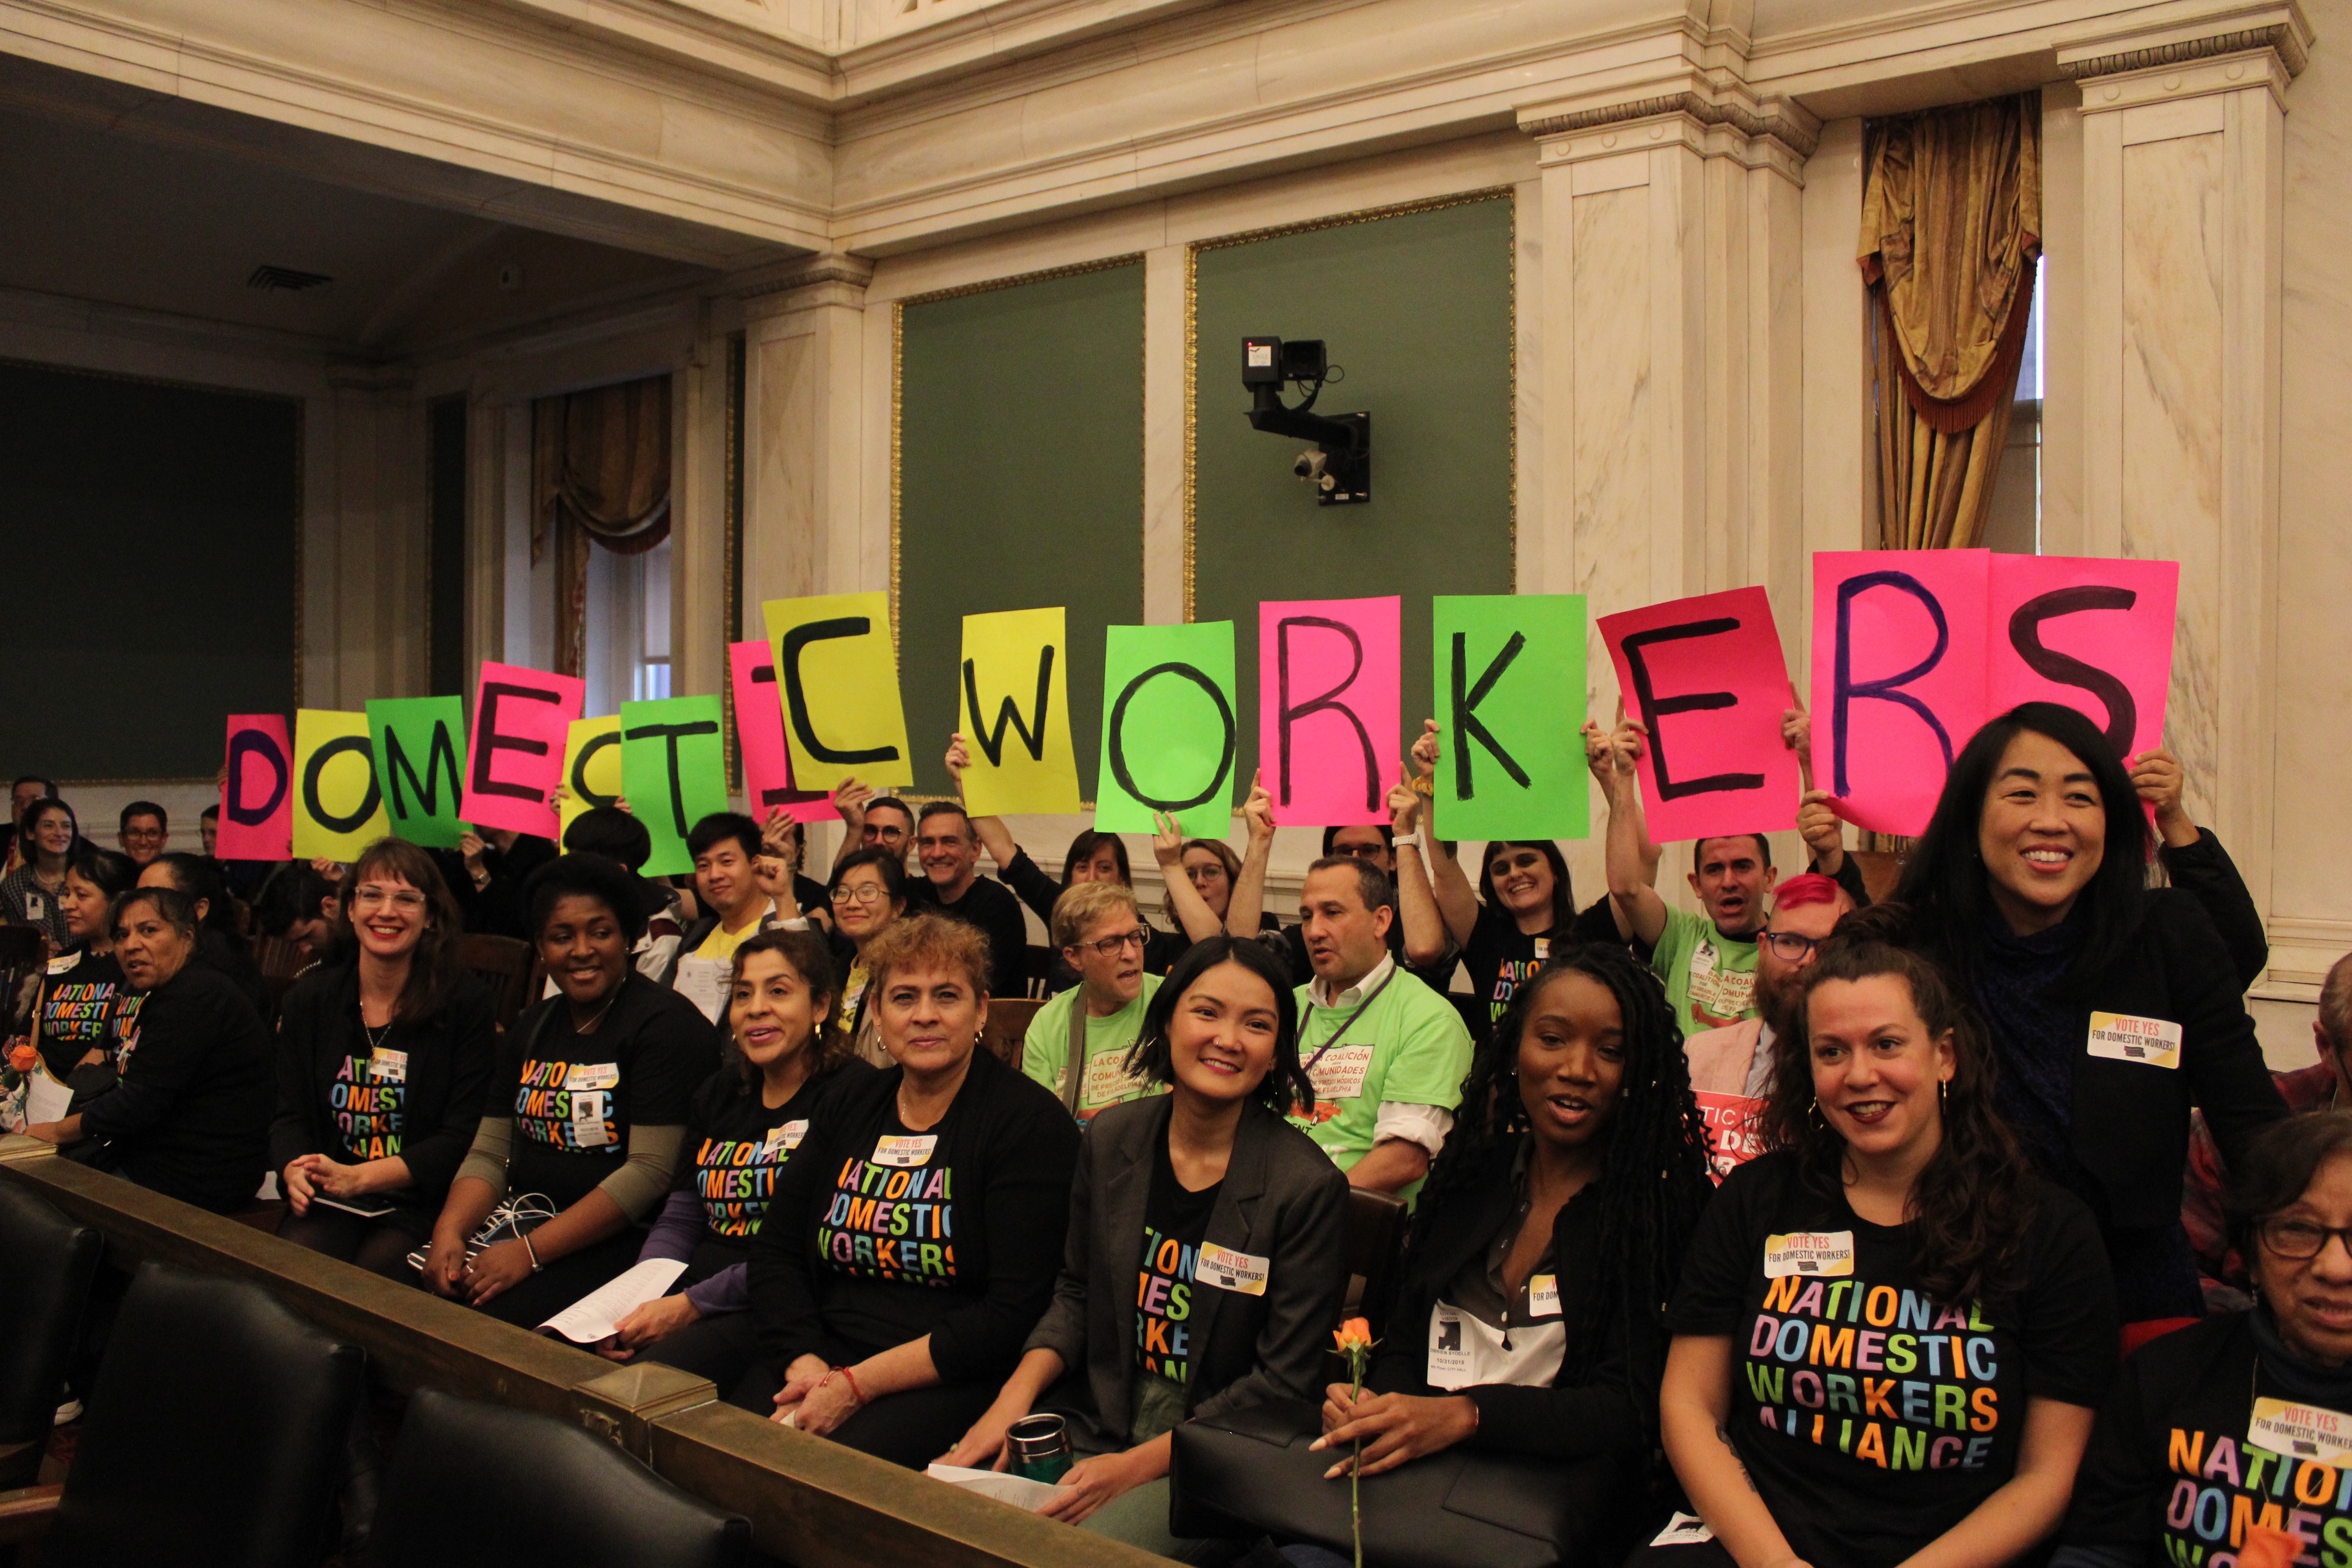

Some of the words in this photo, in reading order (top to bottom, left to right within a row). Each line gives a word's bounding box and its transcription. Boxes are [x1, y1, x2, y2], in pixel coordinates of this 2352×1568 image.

[2116, 1018, 2140, 1033] VOTE
[2142, 1021, 2160, 1036] YES
[2092, 1029, 2105, 1040] FOR
[2107, 1031, 2142, 1045] DOMESTIC
[2144, 1036, 2176, 1051] WORKERS!
[1094, 1058, 1104, 1067] LA
[1325, 1049, 1369, 1061] COALICIÓN
[583, 1067, 596, 1076] VOTE
[597, 1066, 607, 1074] YES
[895, 1139, 911, 1148] VOTE
[912, 1138, 923, 1148] YES
[1788, 1236, 1809, 1249] VOTE
[1813, 1236, 1830, 1249] YES
[1144, 1226, 1200, 1283] ION
[1216, 1250, 1232, 1266] VOTE
[1235, 1256, 1249, 1269] YES
[1769, 1253, 1781, 1262] FOR
[1783, 1250, 1814, 1261] DOMESTIC
[1816, 1249, 1850, 1260] WORKERS!
[1200, 1258, 1210, 1269] FOR
[1210, 1261, 1234, 1276] DOMESTIC
[1235, 1268, 1265, 1281] WORKERS!
[1533, 1292, 1545, 1301] FOR
[1762, 1275, 1994, 1332] NATIONAL
[1749, 1314, 1997, 1381] DOMESTIC
[1746, 1361, 1998, 1432] WORKERS
[2256, 1417, 2272, 1430] FOR
[2273, 1423, 2315, 1440] DOMESTIC
[2284, 1406, 2313, 1426] VOTE
[2316, 1412, 2339, 1432] YES
